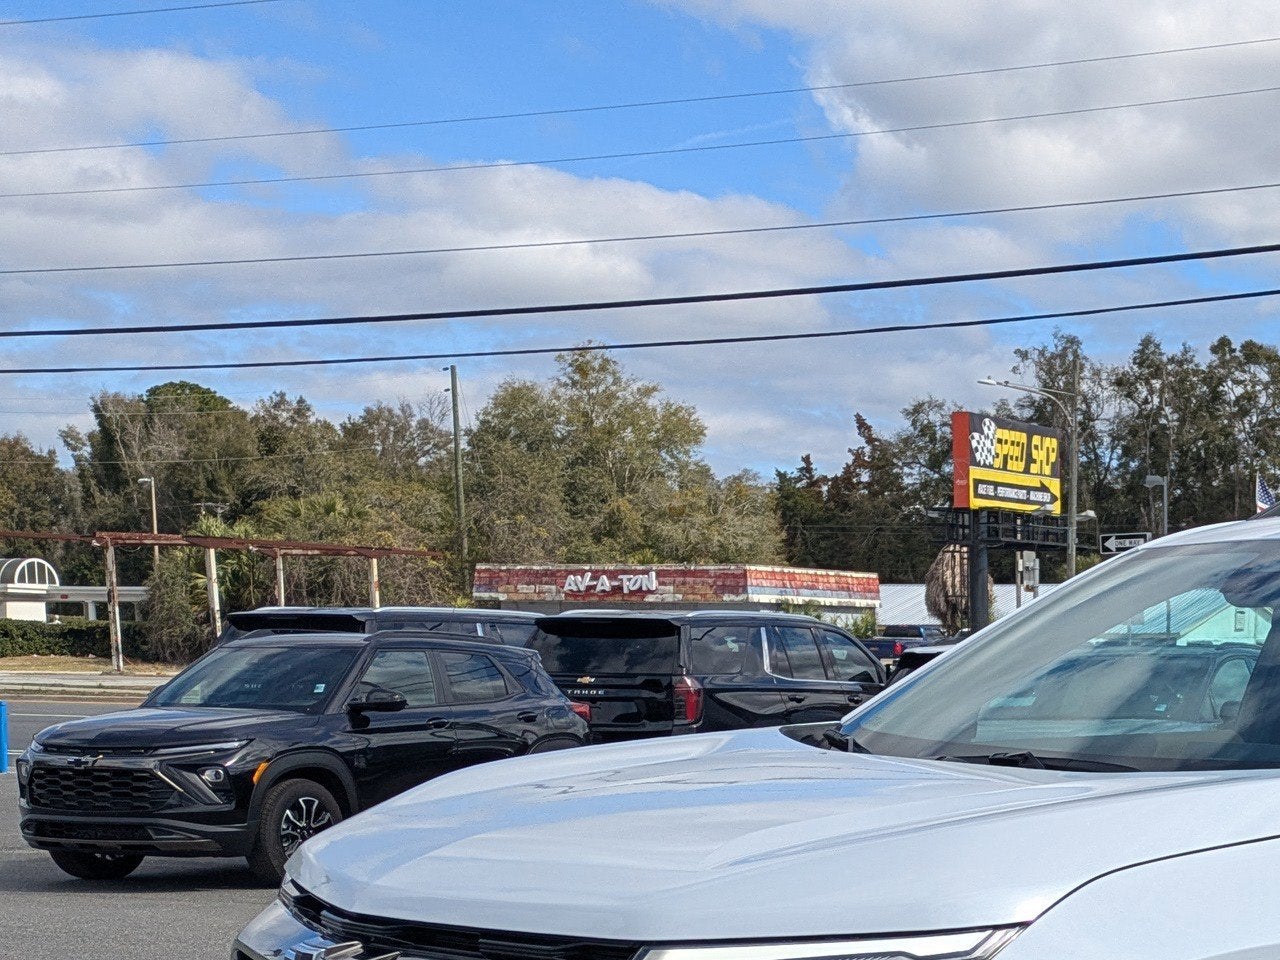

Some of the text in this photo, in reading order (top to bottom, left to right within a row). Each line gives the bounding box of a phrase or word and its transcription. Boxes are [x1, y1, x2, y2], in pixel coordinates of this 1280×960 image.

[993, 428, 1058, 476] SPEED SHOP
[563, 571, 656, 594] AV-A-TON
